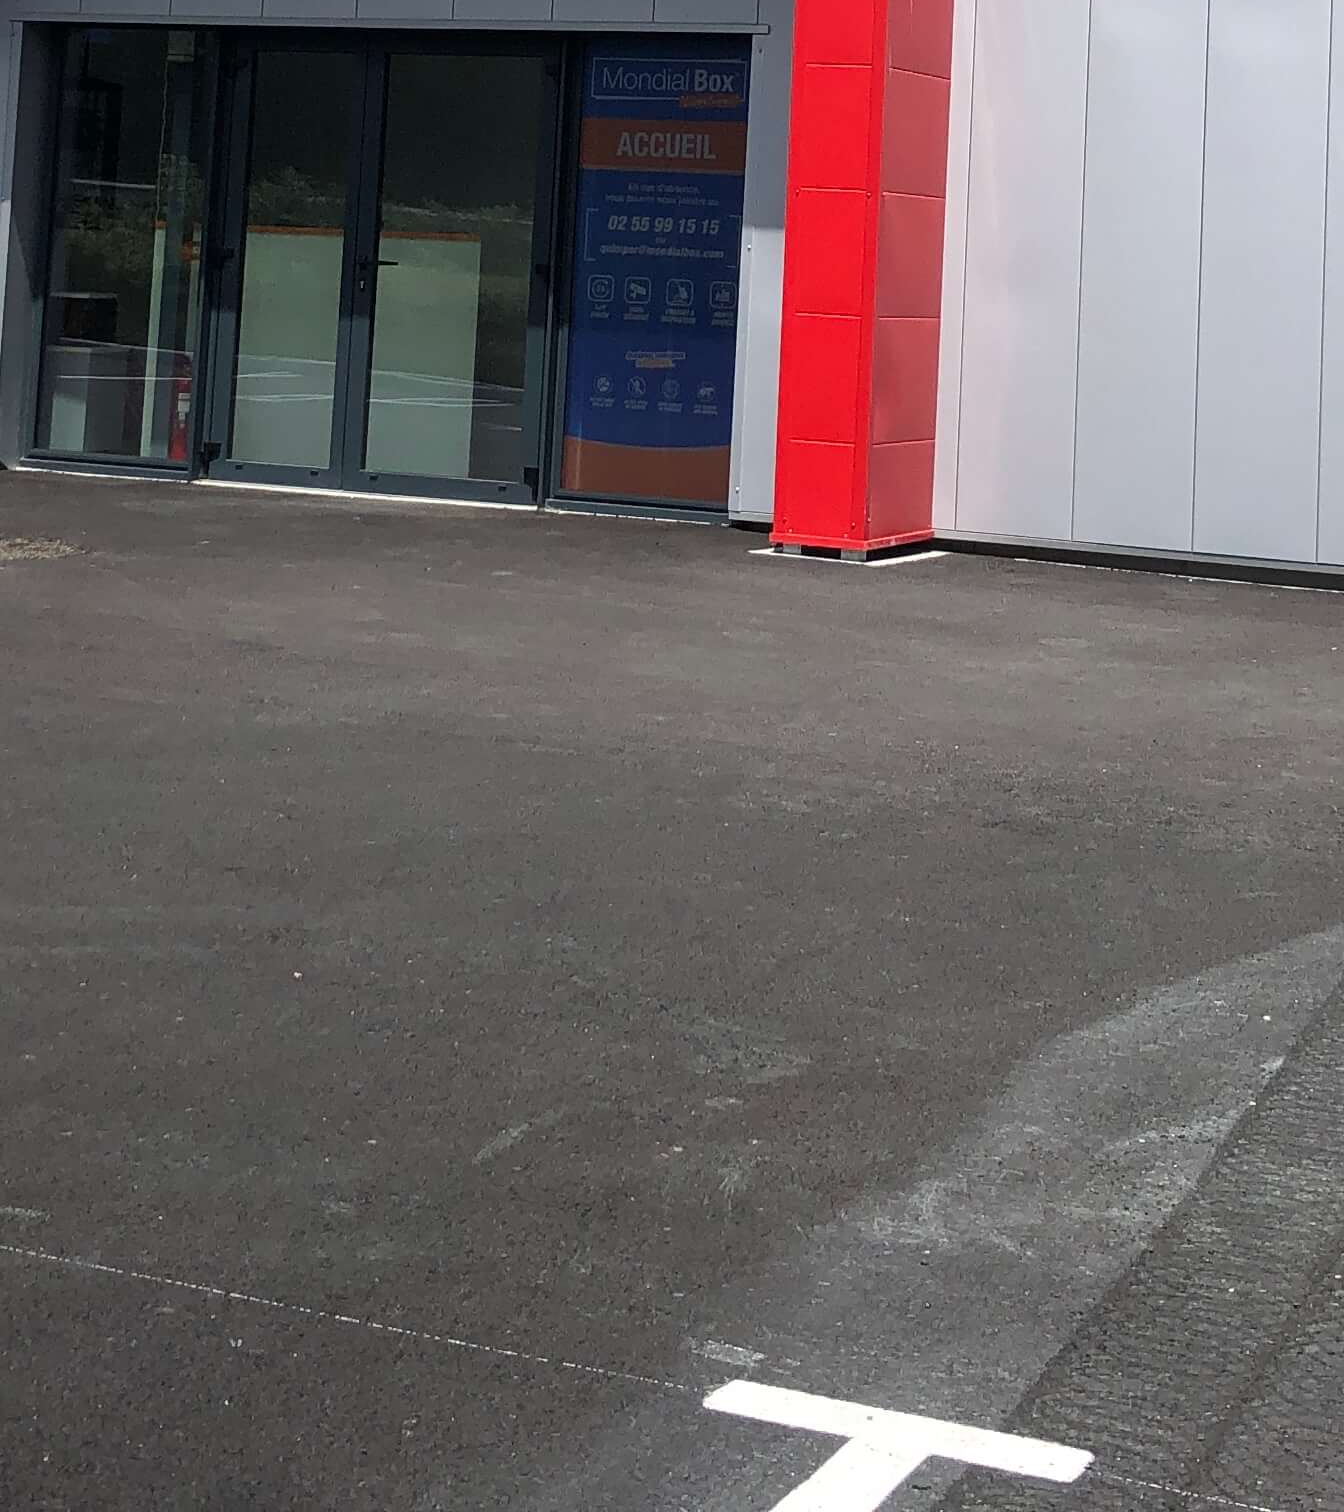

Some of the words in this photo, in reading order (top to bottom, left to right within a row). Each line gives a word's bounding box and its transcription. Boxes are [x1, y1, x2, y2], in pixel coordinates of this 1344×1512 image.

[602, 66, 690, 92] Mondial
[694, 69, 734, 93] Box
[616, 132, 717, 160] ACCUEIL
[607, 215, 628, 231] 02
[654, 217, 673, 233] 99
[678, 218, 697, 235] 15
[701, 219, 720, 235] 15
